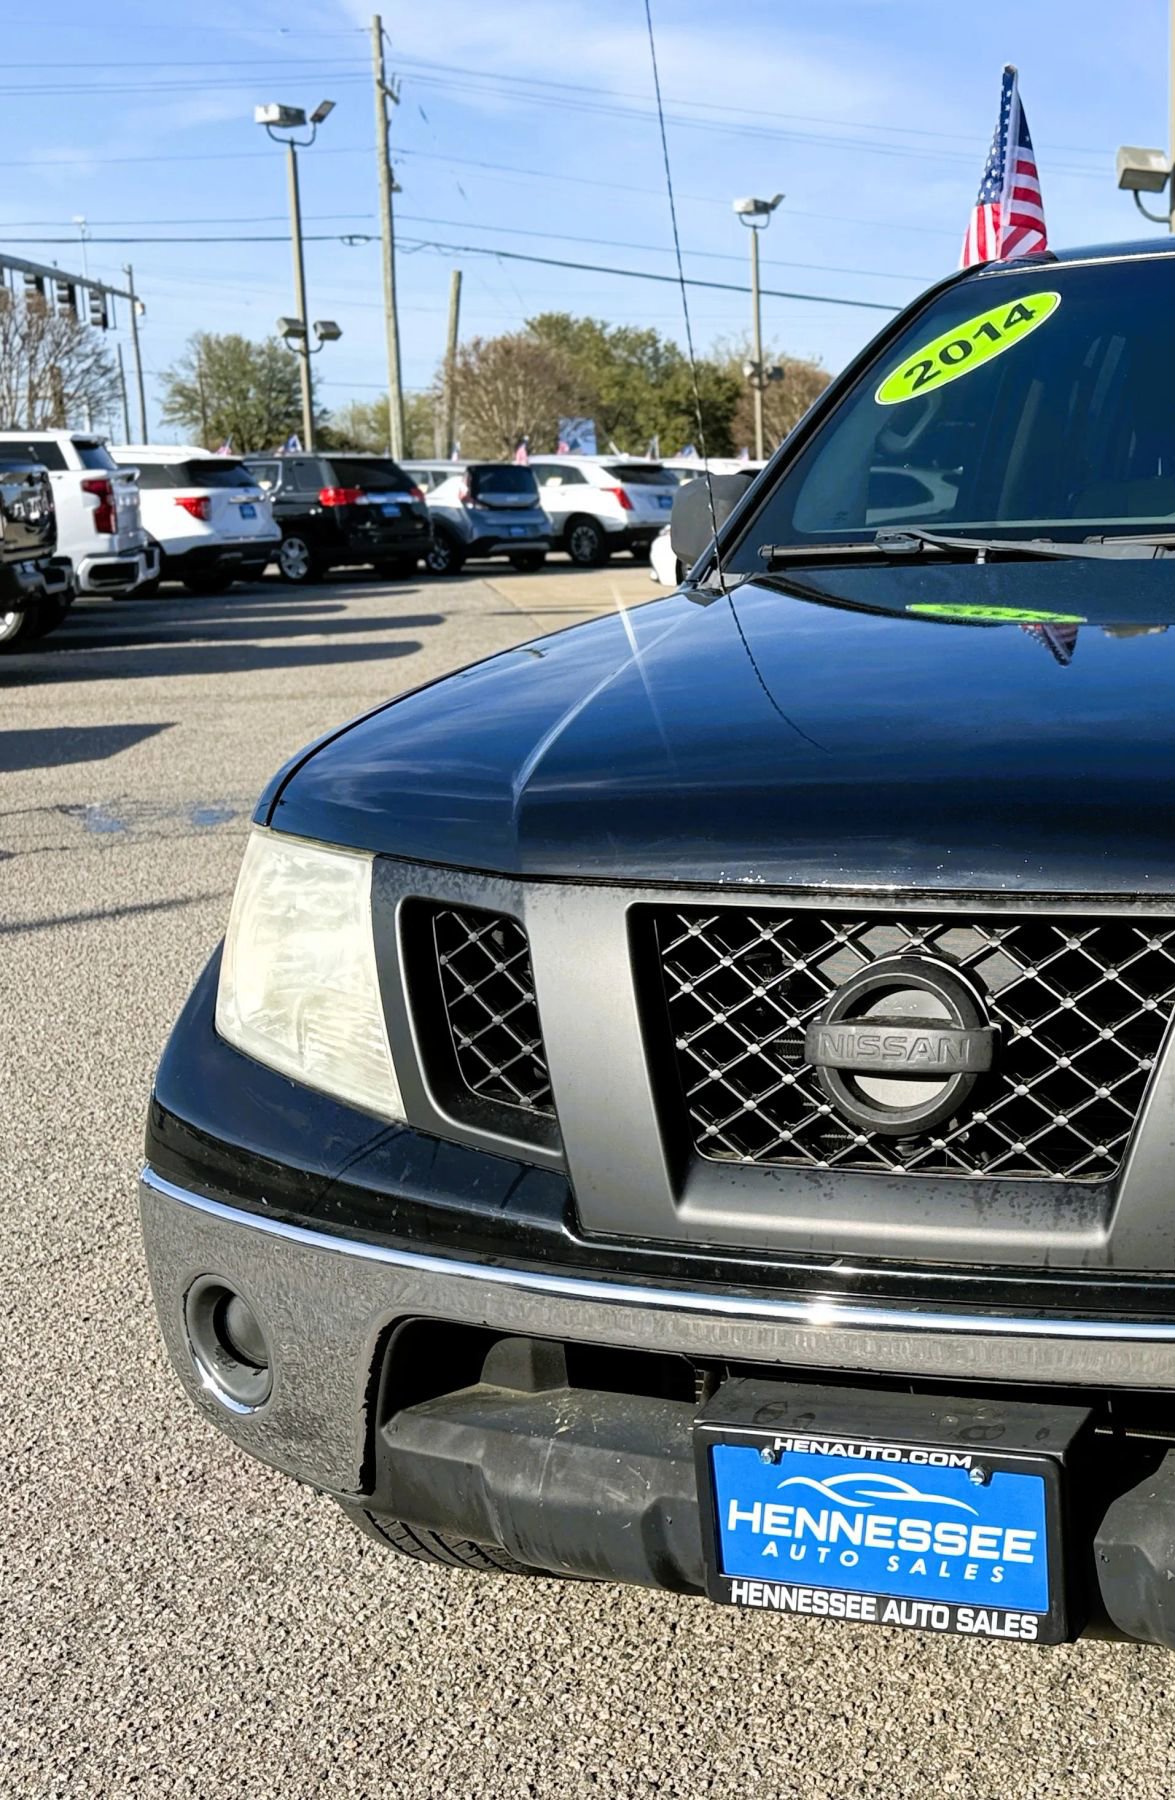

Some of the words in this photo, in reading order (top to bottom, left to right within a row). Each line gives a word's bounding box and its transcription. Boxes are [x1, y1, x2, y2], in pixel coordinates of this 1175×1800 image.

[904, 303, 1036, 391] 2014
[818, 1033, 969, 1064] NISSAN
[774, 1437, 972, 1469] HENAUTO.COM
[727, 1499, 1037, 1564] HENNESSEE
[761, 1541, 859, 1567] AUTO
[887, 1555, 1005, 1583] SALES
[732, 1580, 876, 1621] HENNESSEE
[882, 1600, 949, 1630] AUTO
[956, 1609, 1038, 1640] SALES
